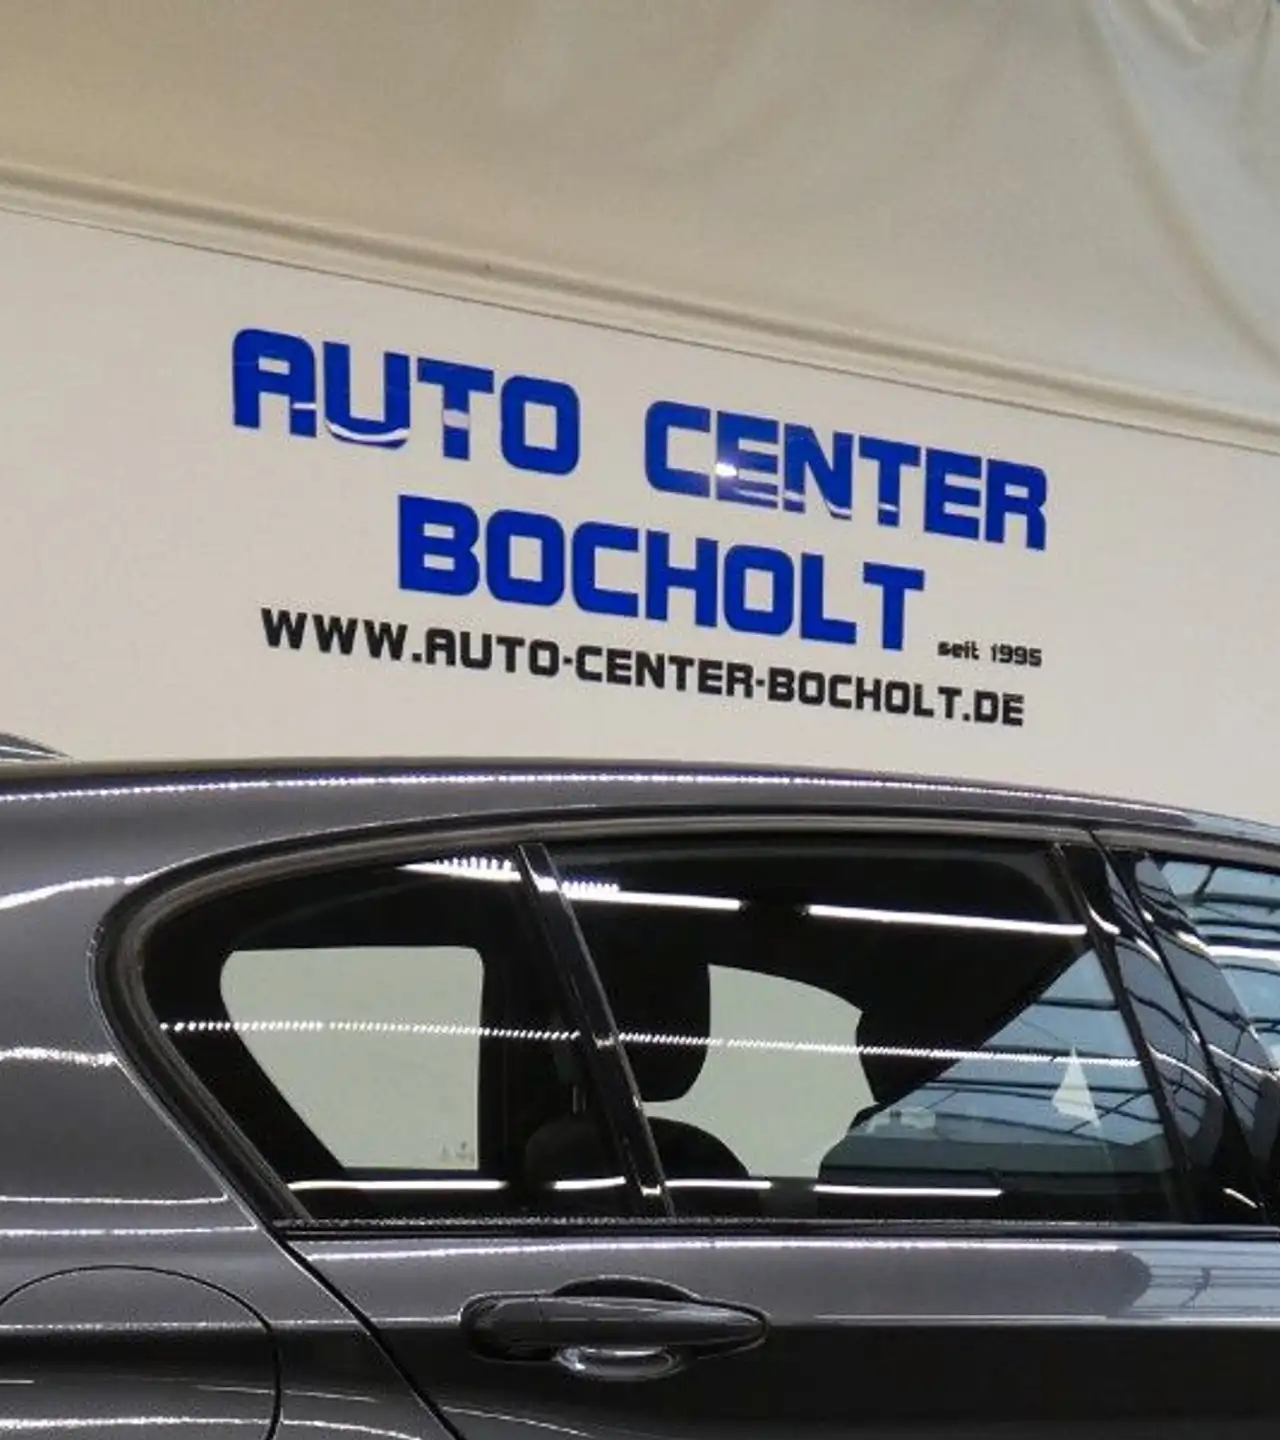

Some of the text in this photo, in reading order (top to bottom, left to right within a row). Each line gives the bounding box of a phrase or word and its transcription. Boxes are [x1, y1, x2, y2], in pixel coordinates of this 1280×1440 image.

[232, 328, 1048, 551] AUTO CENTER
[398, 494, 925, 652] BOCHOLT
[260, 607, 1024, 727] WWW.AUTO-CENTER-BOCHOLT.DE
[937, 640, 1042, 668] seit 1995
